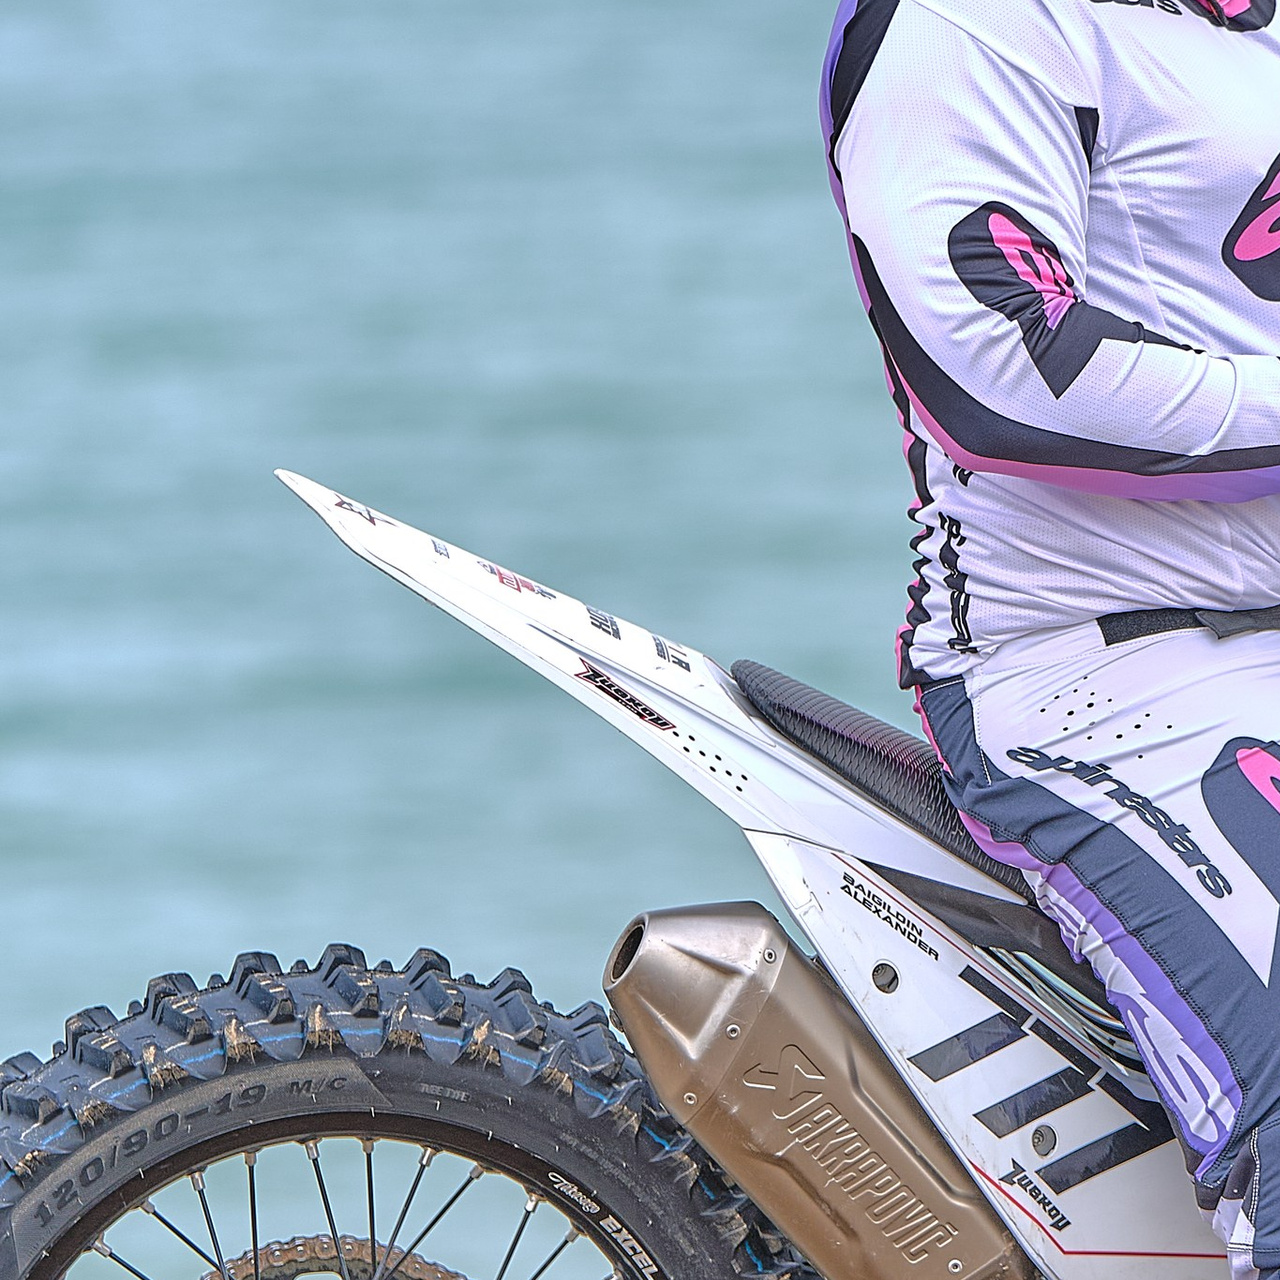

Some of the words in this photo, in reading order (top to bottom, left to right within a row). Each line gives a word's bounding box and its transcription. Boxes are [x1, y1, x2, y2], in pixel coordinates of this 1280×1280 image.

[1006, 746, 1233, 899] alpinestars
[840, 884, 940, 961] ALEXANDER
[842, 871, 923, 938] BAIGILDIN
